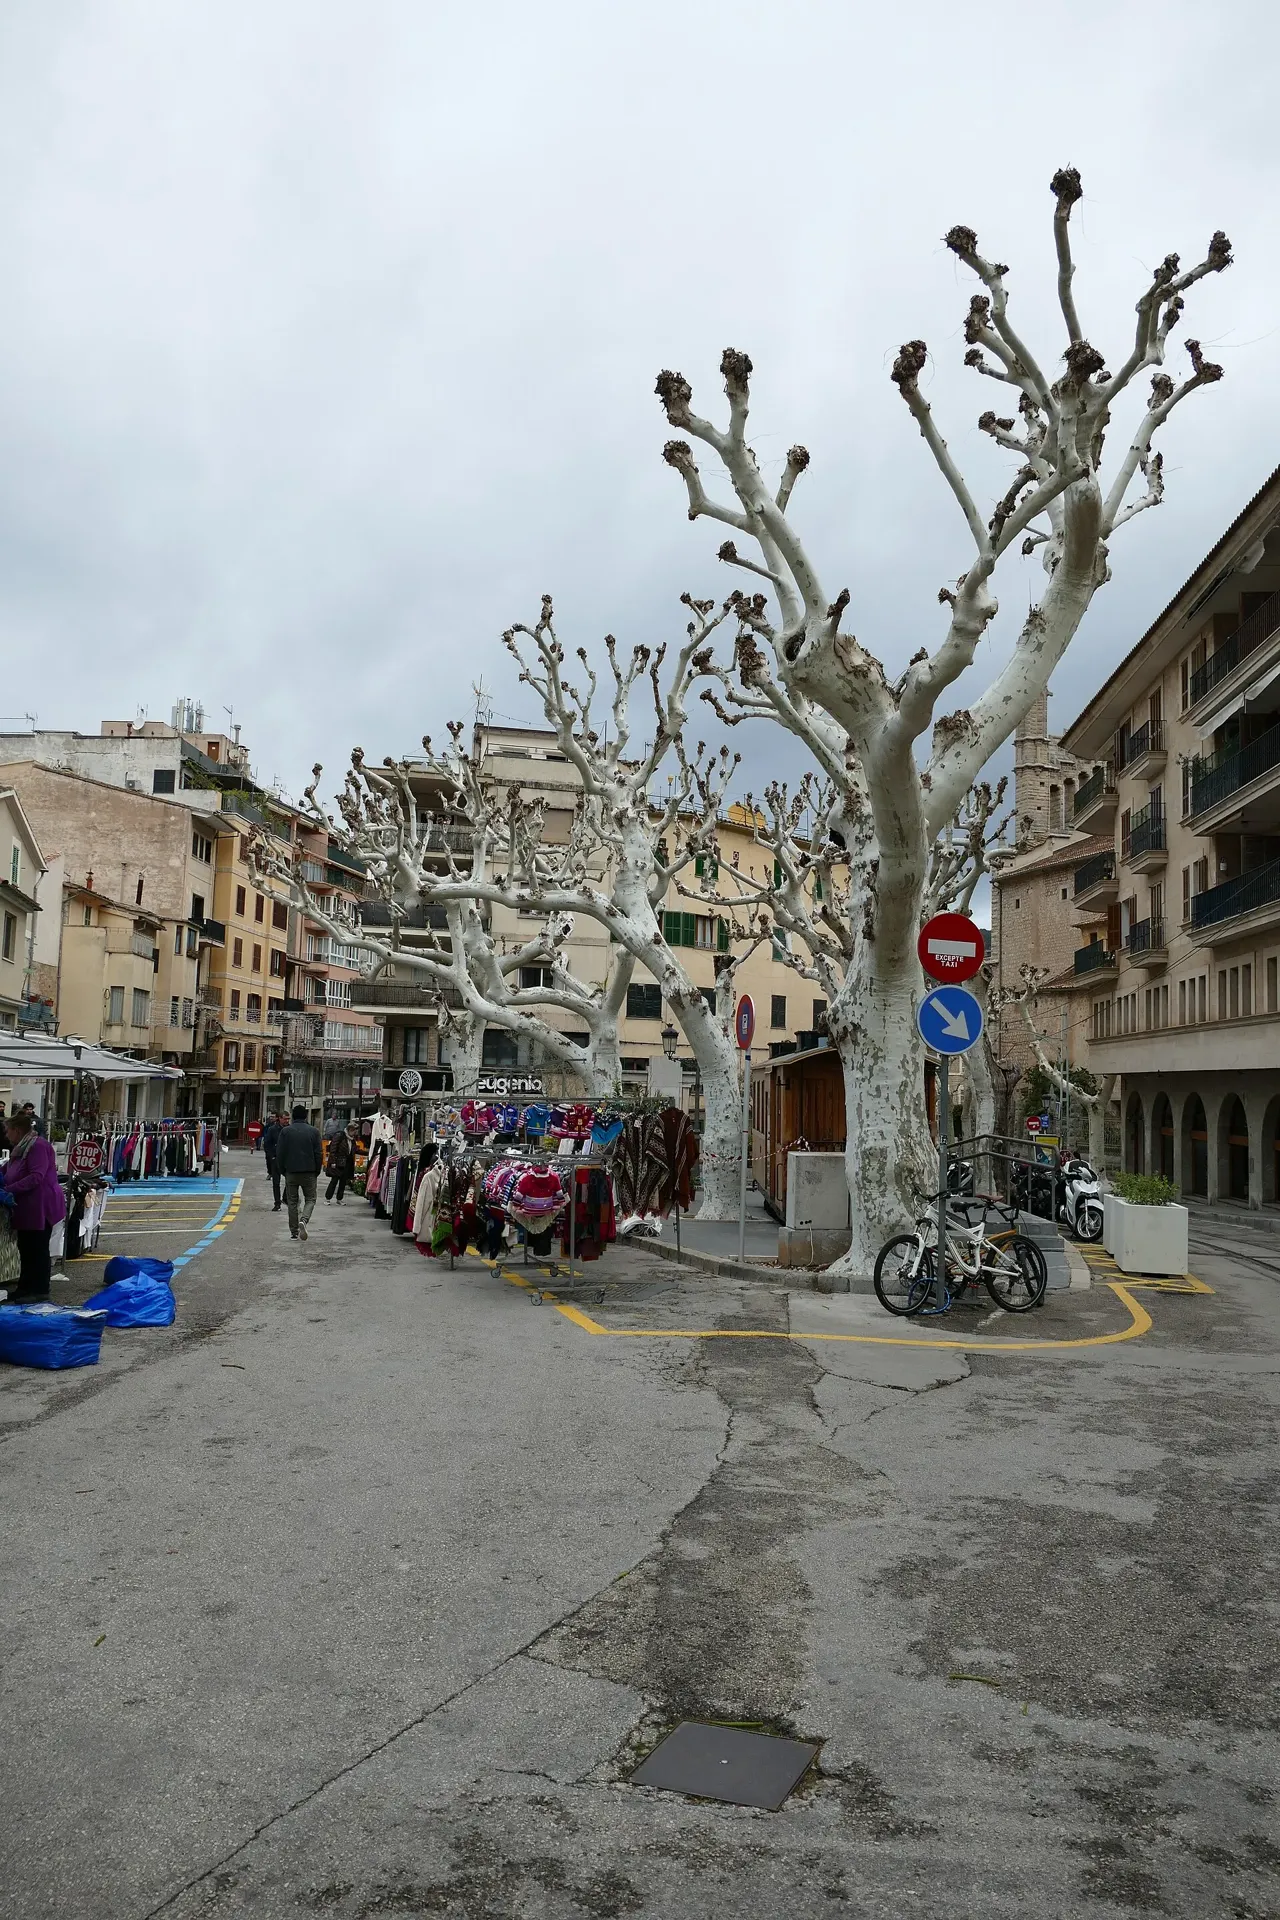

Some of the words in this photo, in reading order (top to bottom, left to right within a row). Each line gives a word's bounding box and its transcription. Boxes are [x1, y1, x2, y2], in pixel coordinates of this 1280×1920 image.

[935, 954, 964, 962] EXCEPTE
[76, 1145, 99, 1157] STOP
[75, 1155, 97, 1168] 10€
